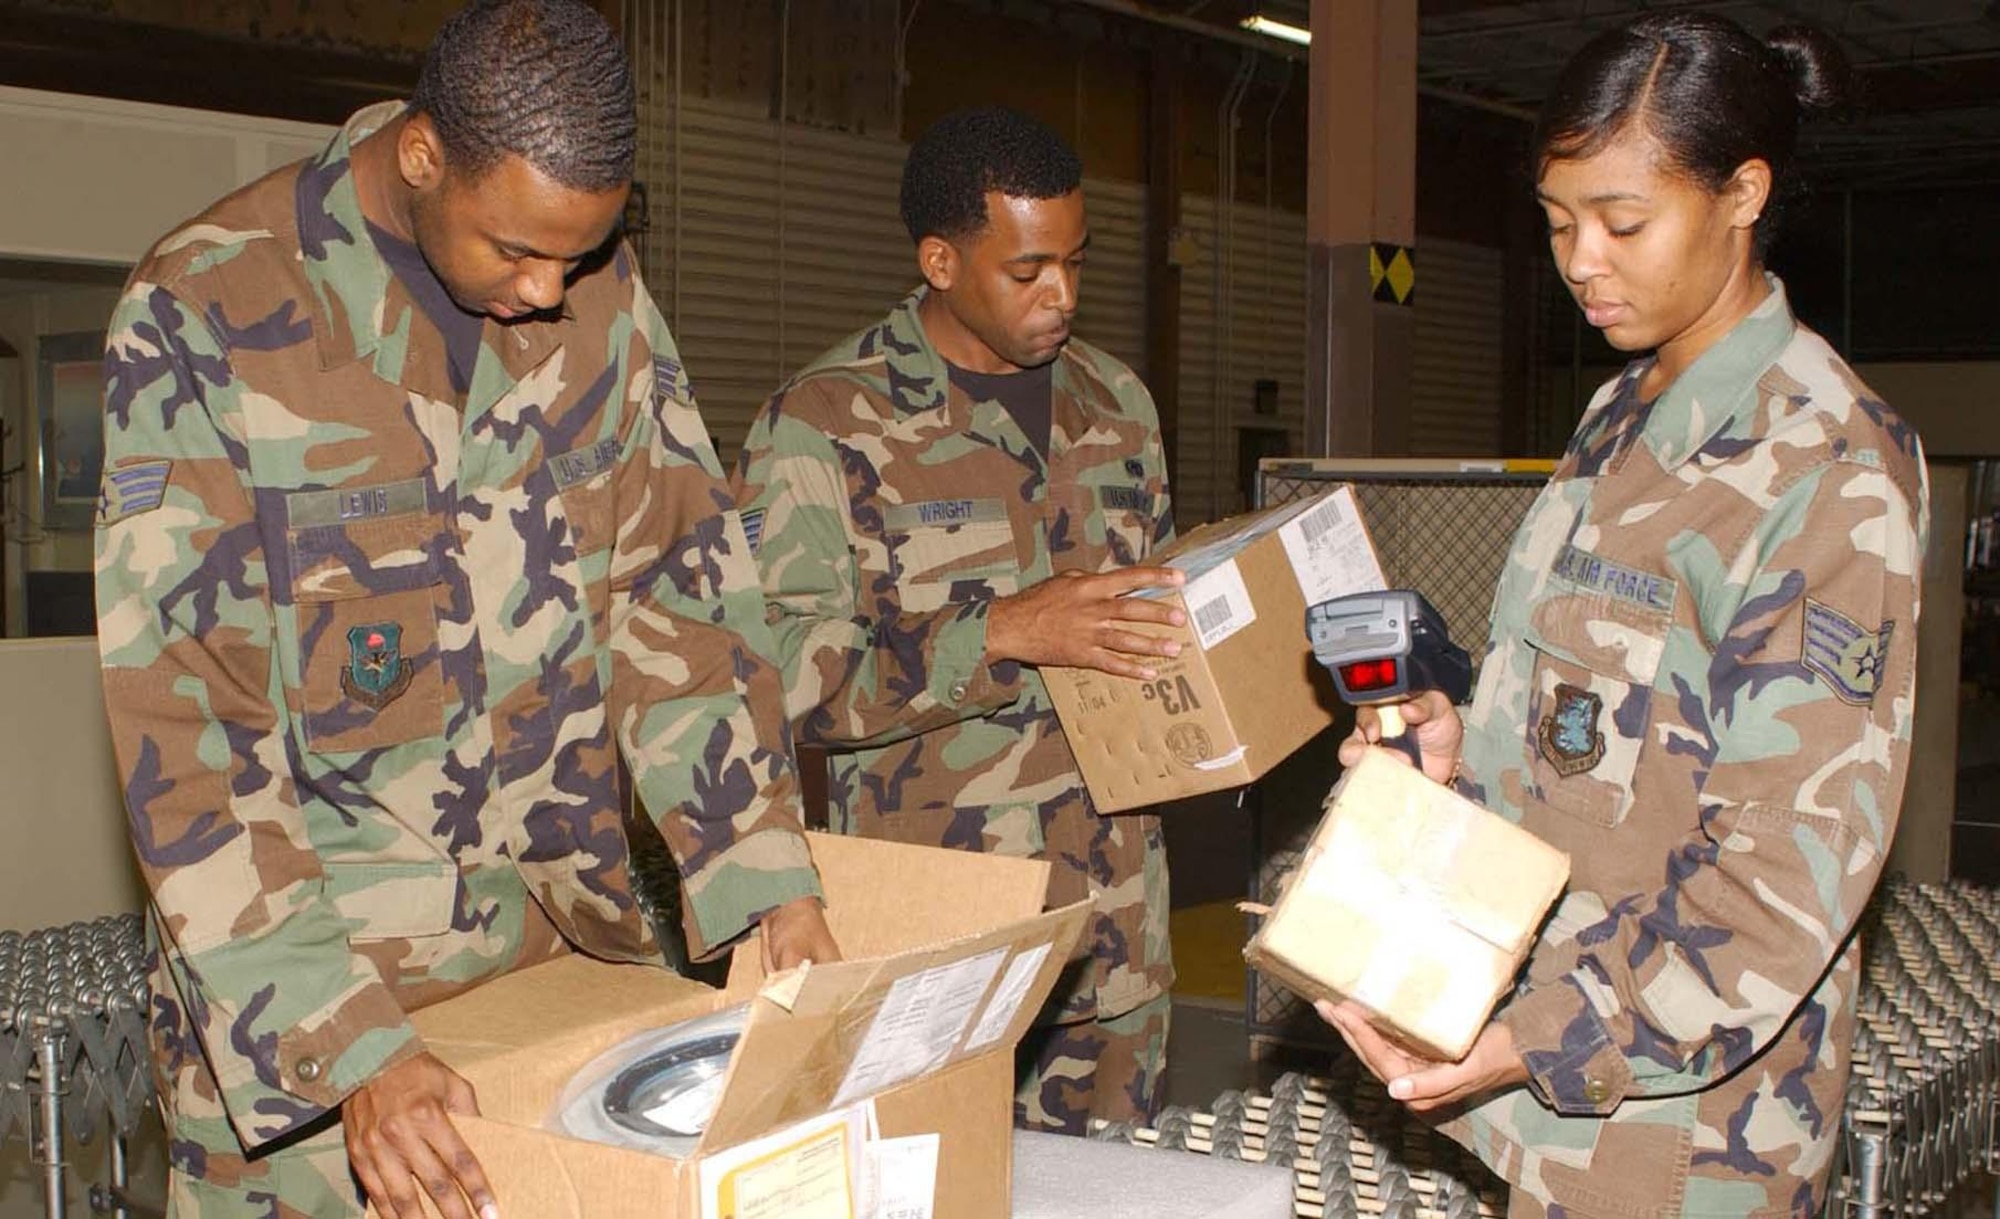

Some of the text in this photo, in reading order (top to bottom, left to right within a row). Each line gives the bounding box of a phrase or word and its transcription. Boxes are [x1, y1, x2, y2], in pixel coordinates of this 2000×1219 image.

[338, 488, 388, 518] LEWIS
[919, 501, 973, 522] WRIGHT
[1577, 556, 1600, 585] AIR
[1604, 566, 1660, 604] FORCE
